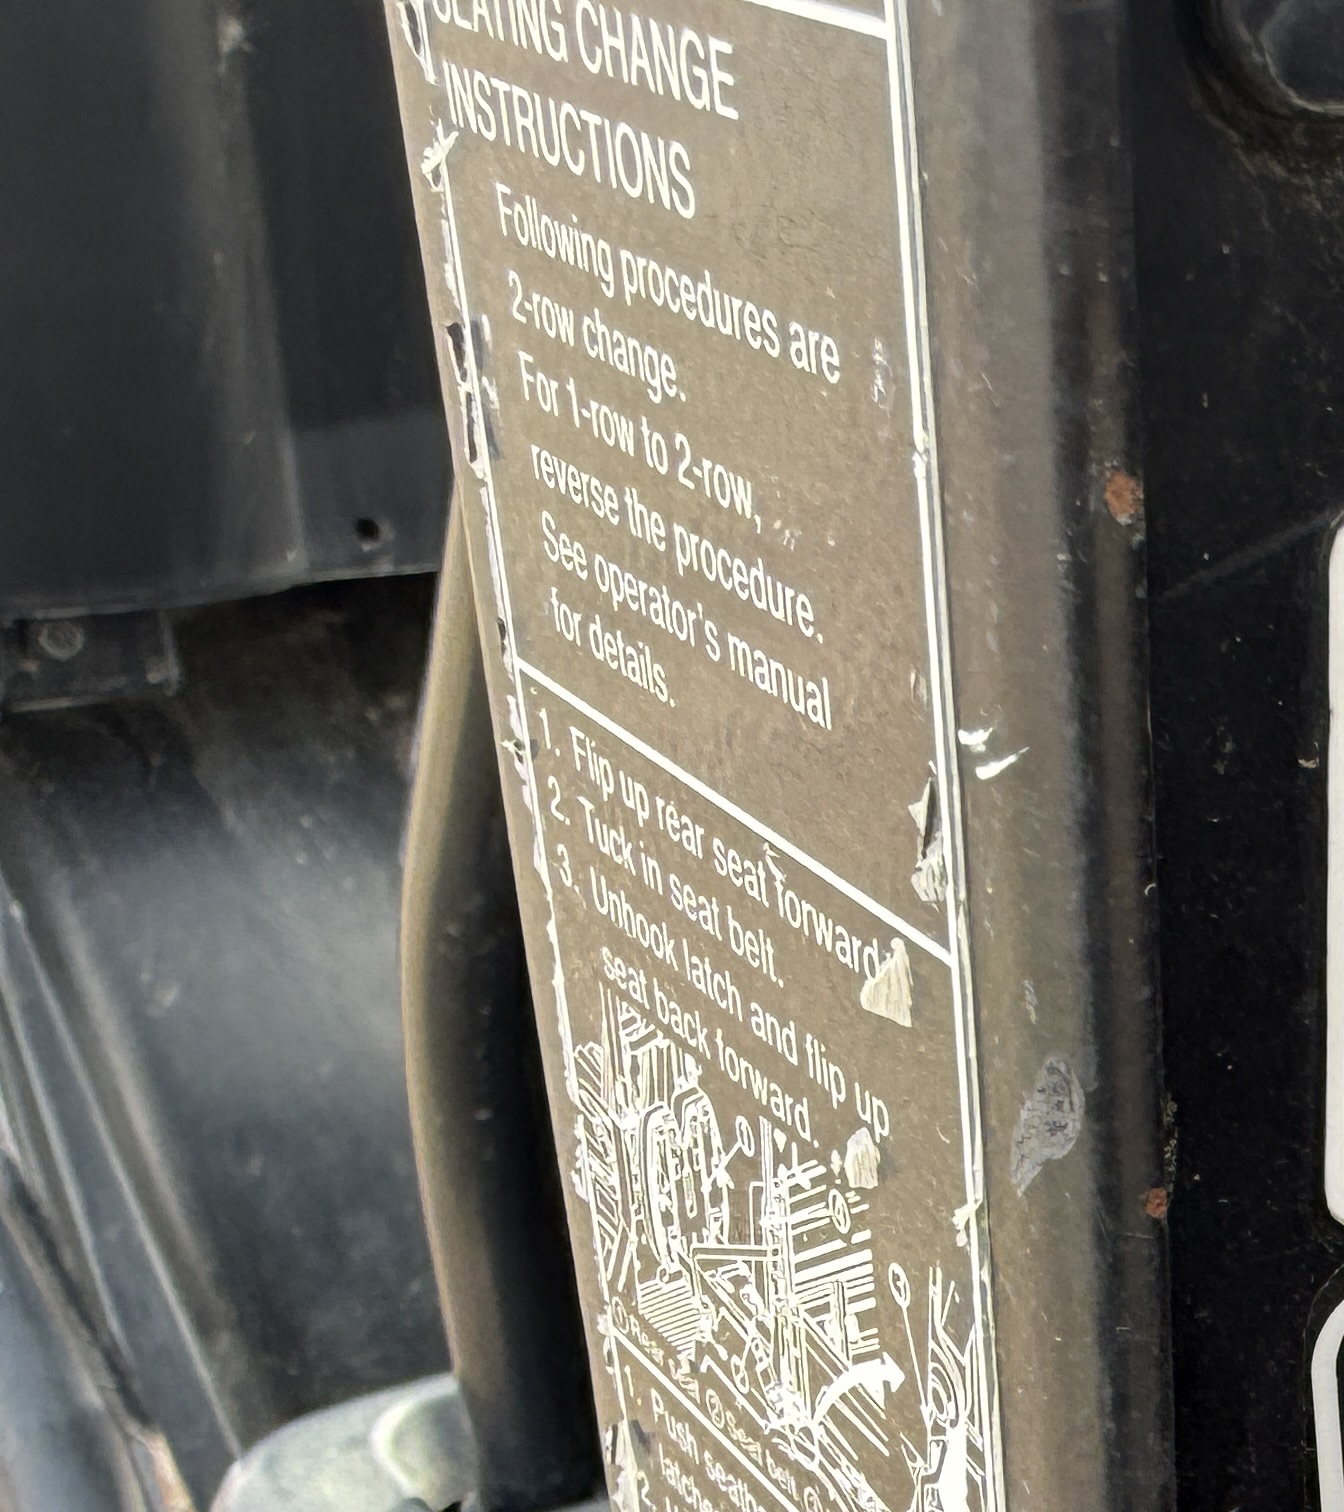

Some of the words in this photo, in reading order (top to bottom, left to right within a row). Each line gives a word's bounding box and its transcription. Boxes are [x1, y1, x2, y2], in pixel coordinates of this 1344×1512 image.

[442, 59, 695, 219] INSTRUCTIONS
[576, 0, 738, 120] CHANGE
[495, 182, 614, 298] Following
[620, 249, 780, 357] procedures
[789, 322, 840, 383] are
[508, 270, 574, 346] 2-row
[582, 308, 686, 403] change.
[518, 351, 558, 416] For
[566, 378, 634, 456] 1-row
[641, 416, 668, 474] to
[675, 433, 761, 533] 2-row,
[531, 445, 619, 525] reverse
[625, 487, 665, 551] the
[674, 523, 823, 644] procedure.
[542, 511, 588, 580] See
[595, 554, 720, 661] operator's
[728, 633, 831, 730] manual
[551, 587, 582, 646] for
[589, 615, 675, 707] details.
[539, 708, 560, 756] 1.
[569, 726, 614, 801] Flip
[619, 771, 649, 827] up
[656, 797, 704, 859] rear
[713, 838, 769, 907] seat
[548, 776, 570, 825] 2.
[577, 796, 636, 876] Tuck
[640, 841, 663, 895] in
[670, 874, 722, 941] seat
[727, 905, 783, 987] belt.
[590, 866, 678, 971] Unhook
[683, 938, 742, 1022] latch
[751, 1002, 798, 1065] and
[806, 1033, 846, 1109] flip
[855, 1082, 889, 1143] up
[600, 947, 650, 1009] seat
[653, 978, 711, 1059] back
[715, 1028, 819, 1148] forward.
[651, 1388, 699, 1464] Push
